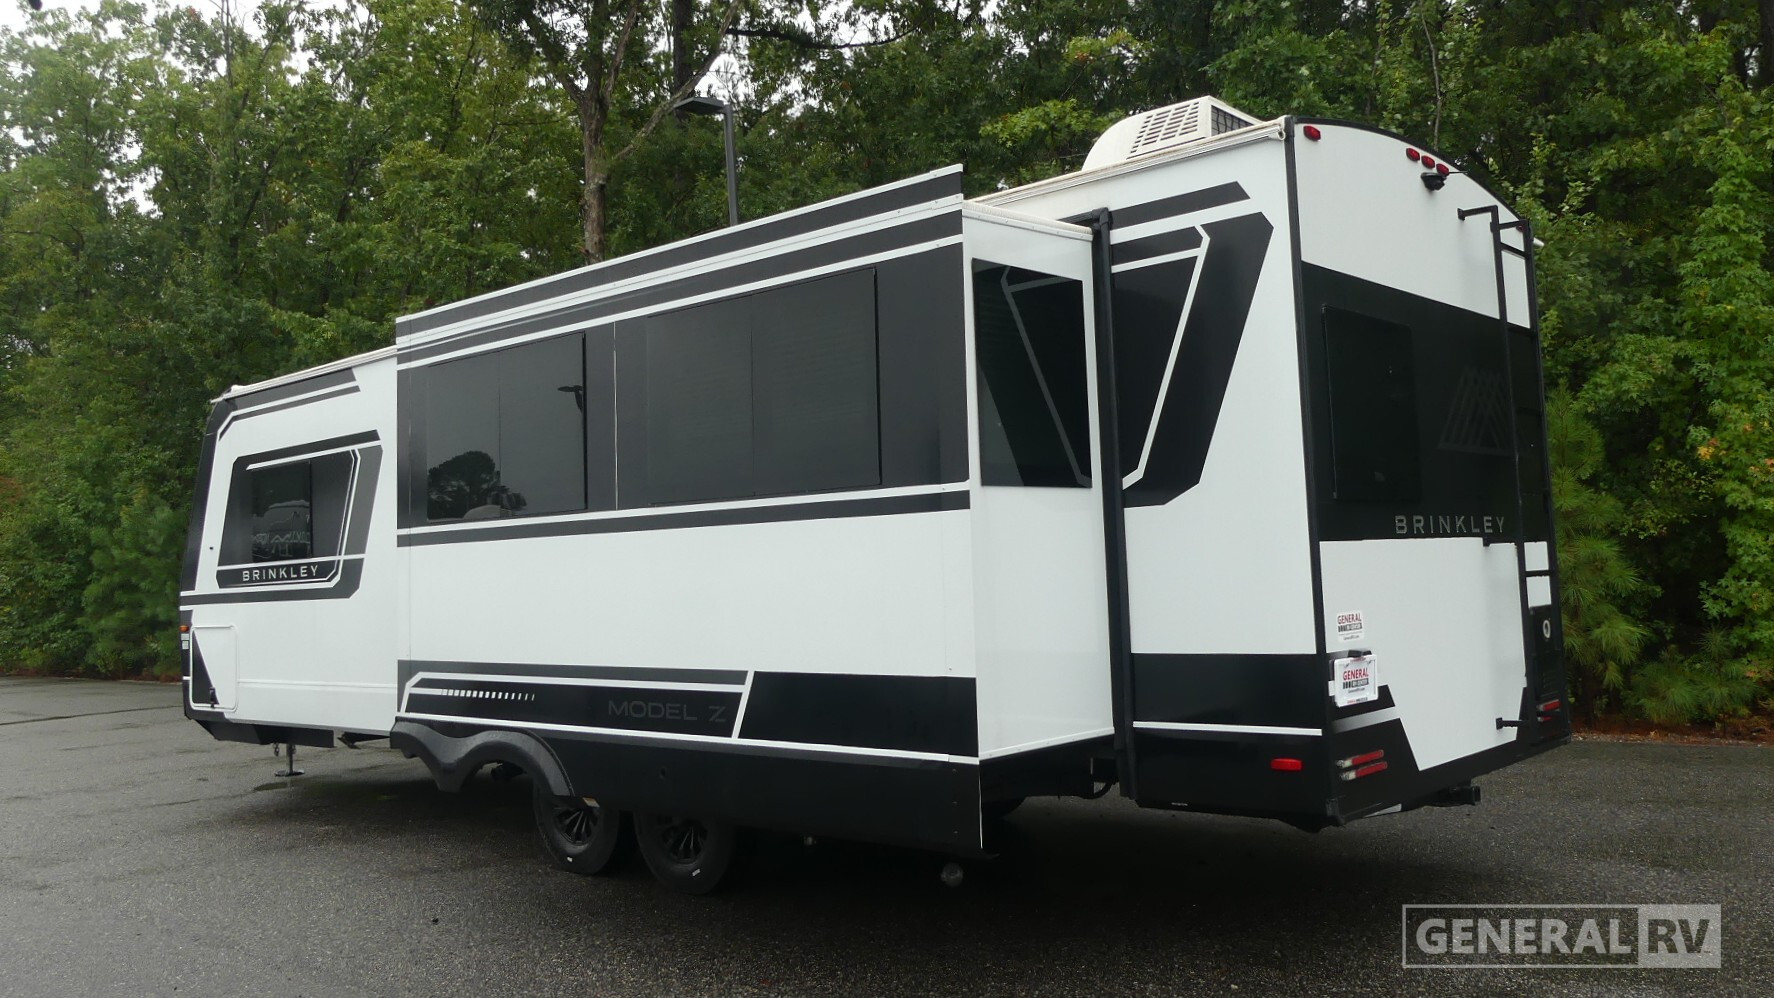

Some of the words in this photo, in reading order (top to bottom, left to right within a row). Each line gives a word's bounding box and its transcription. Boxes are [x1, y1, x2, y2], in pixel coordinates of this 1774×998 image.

[1395, 515, 1505, 534] BRINKLEY
[242, 565, 318, 582] BRINKLEY
[1337, 613, 1362, 625] GENERAL
[1343, 668, 1369, 681] GENERAL
[608, 700, 697, 721] MODEL
[708, 705, 726, 722] Z
